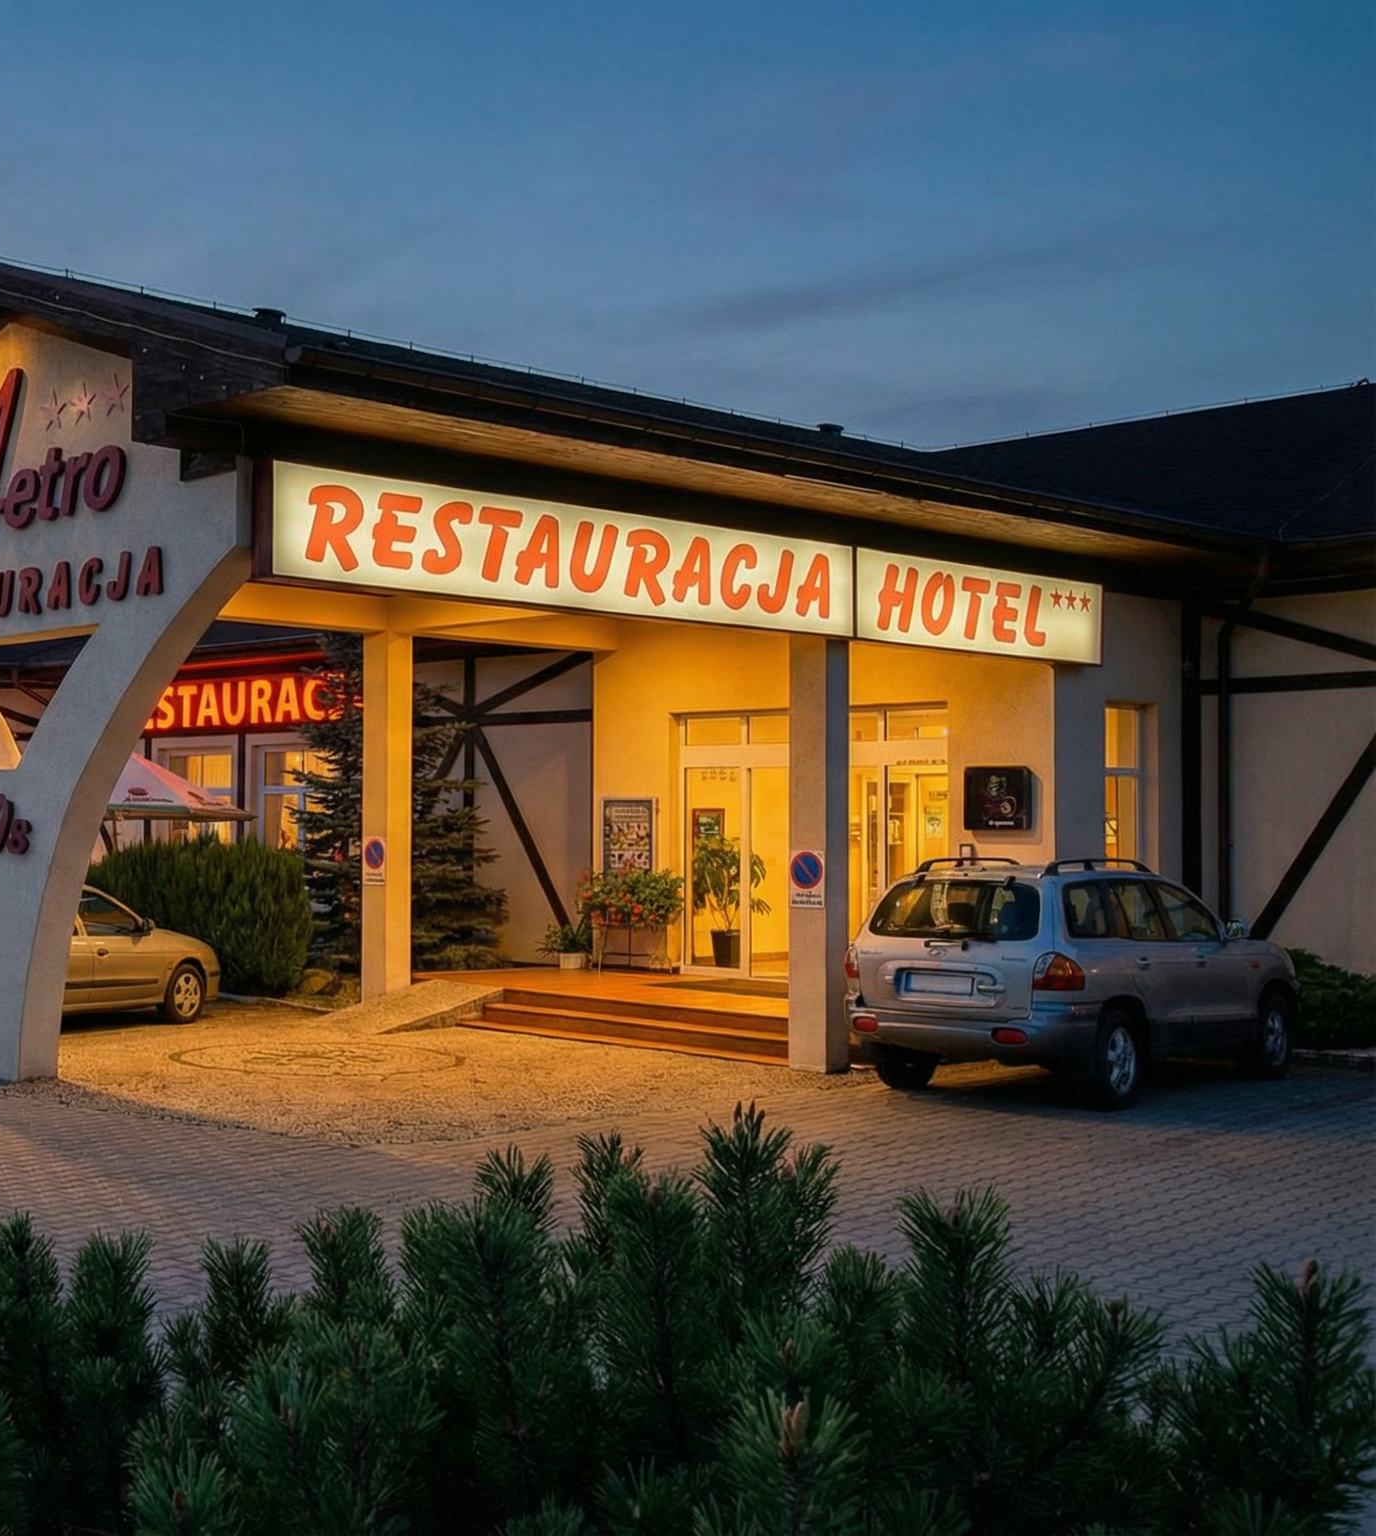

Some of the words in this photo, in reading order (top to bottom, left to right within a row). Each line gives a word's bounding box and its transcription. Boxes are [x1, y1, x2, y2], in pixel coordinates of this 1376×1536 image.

[306, 484, 830, 620] RESTAURACJA
[877, 563, 1047, 647] HOTEL
[144, 675, 364, 730] STAURAC
